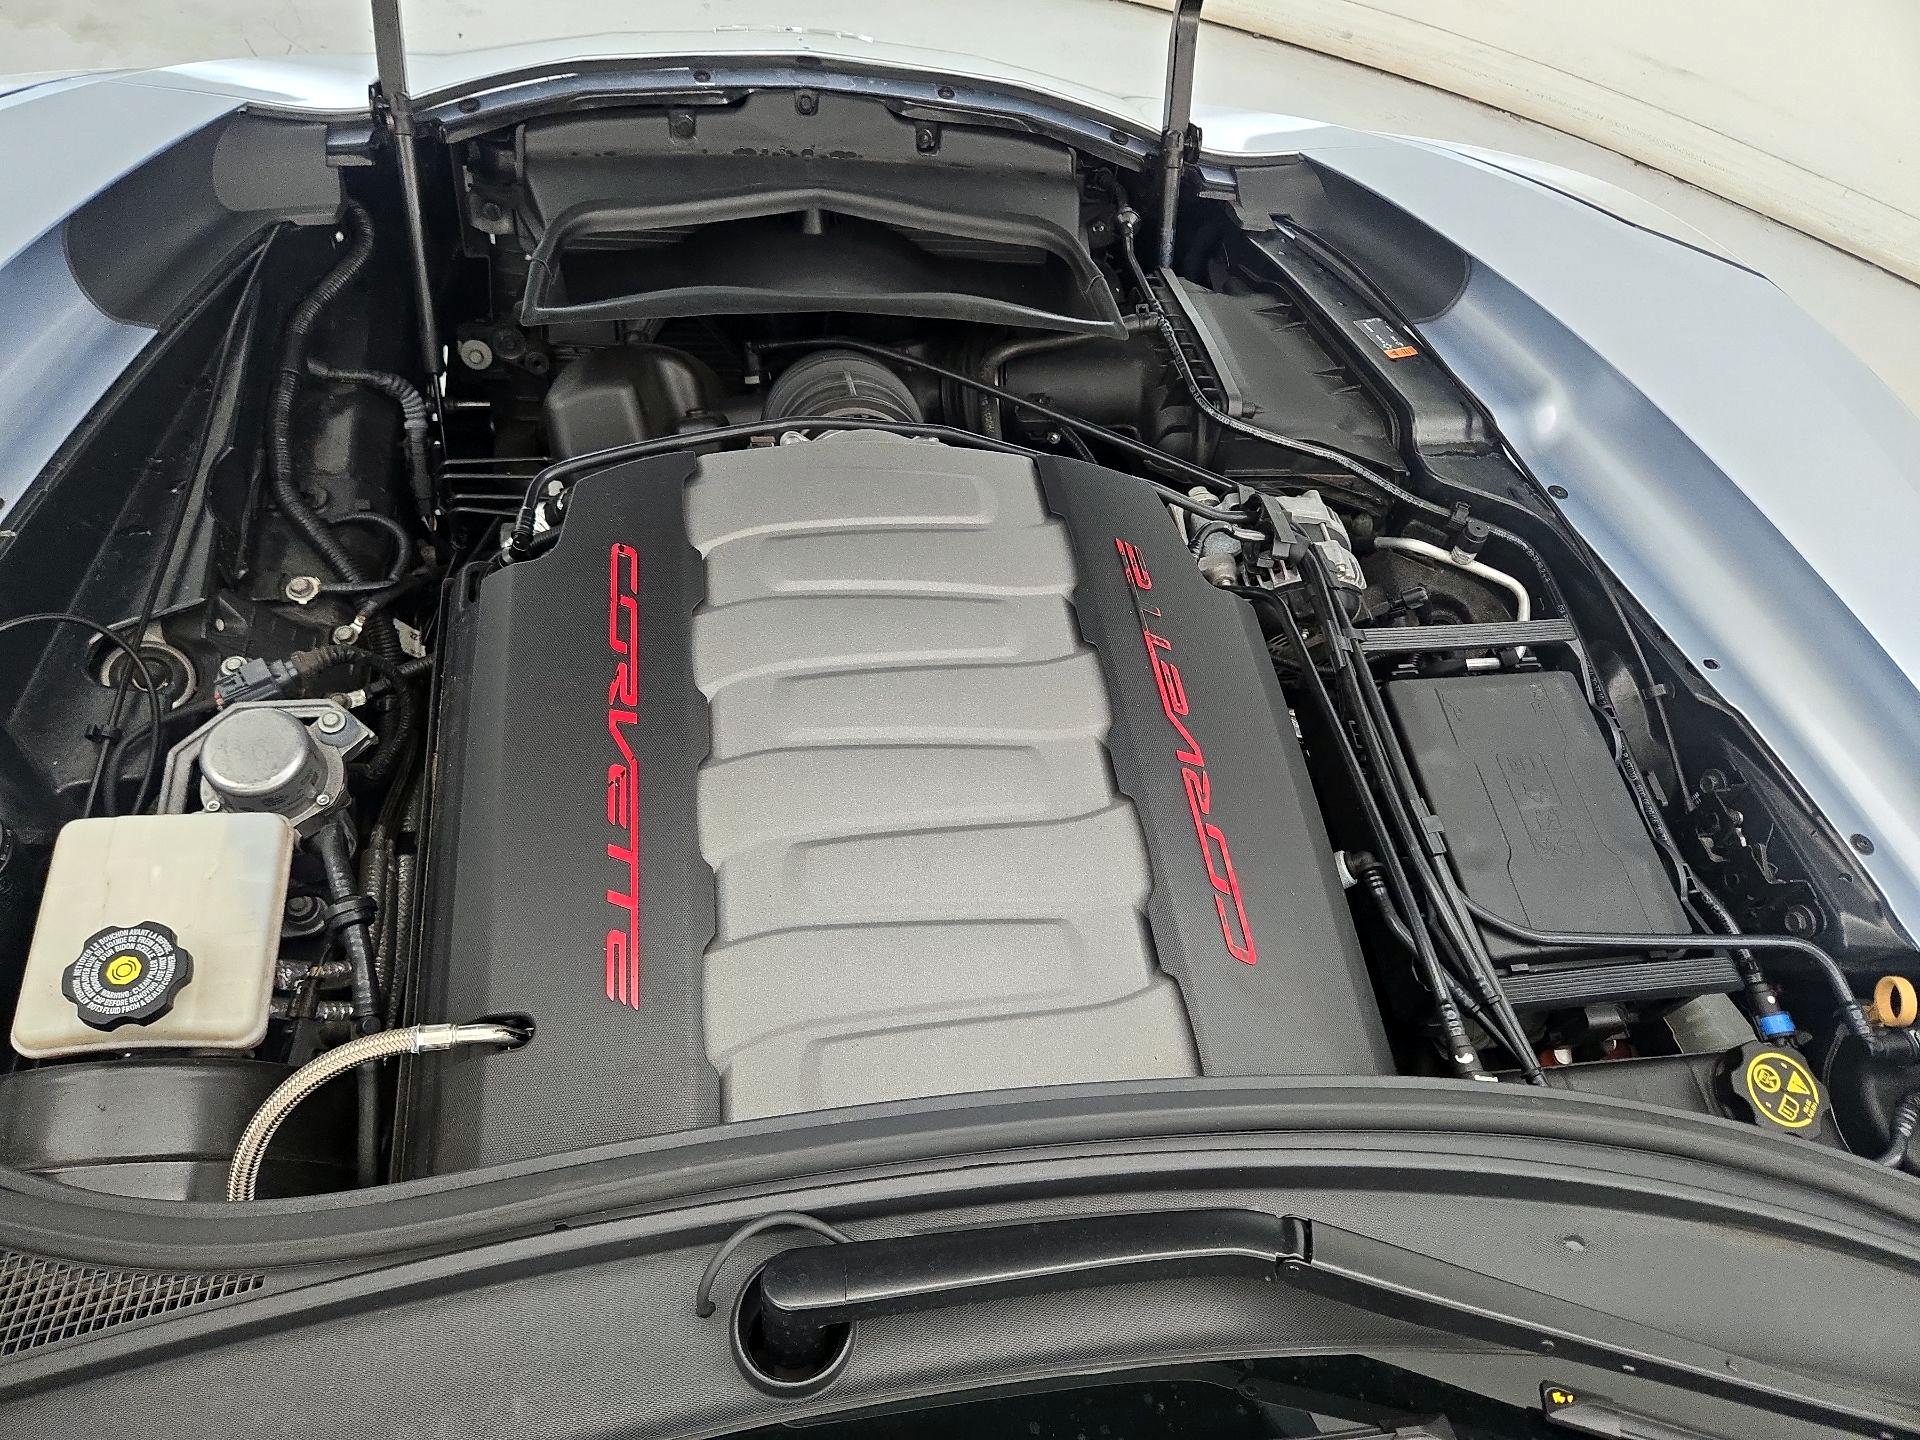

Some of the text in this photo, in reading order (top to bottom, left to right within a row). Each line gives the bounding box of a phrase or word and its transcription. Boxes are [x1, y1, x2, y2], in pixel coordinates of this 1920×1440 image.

[1115, 537, 1257, 966] CORVETTE
[606, 542, 639, 1011] CORVETTE
[73, 949, 94, 976] NETTOYER
[90, 942, 101, 951] LE
[98, 930, 129, 945] BOUCHON
[129, 928, 150, 936] AVANT
[147, 931, 158, 939] LA
[85, 955, 98, 967] QUE
[94, 947, 105, 956] DU
[103, 936, 127, 950] LIQUIDE
[137, 936, 156, 947] FREIN
[114, 943, 136, 952] BIDON
[93, 994, 105, 1004] CAP
[103, 998, 129, 1006] BEFORE
[154, 970, 166, 981] USE
[102, 1006, 121, 1014] FLUID
[121, 1002, 141, 1013] FROM
[144, 984, 166, 1003] SEALED
[132, 977, 152, 994] CLEAN
